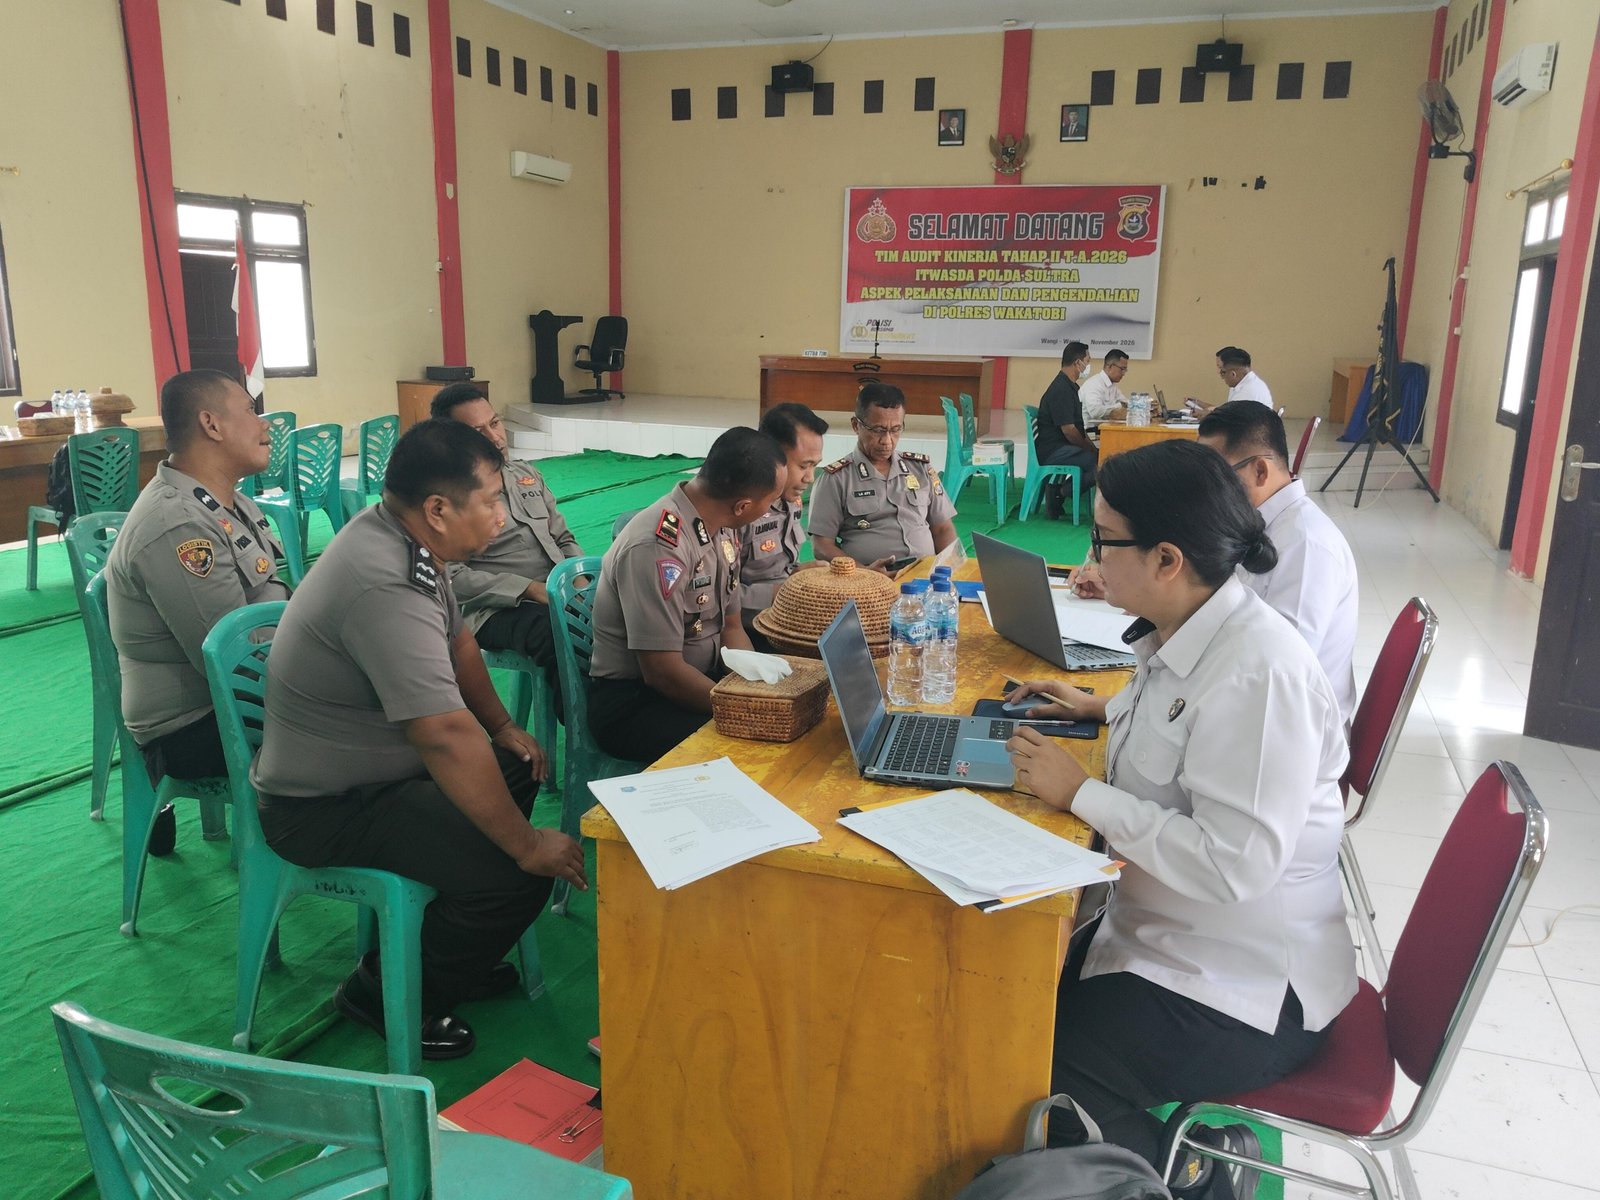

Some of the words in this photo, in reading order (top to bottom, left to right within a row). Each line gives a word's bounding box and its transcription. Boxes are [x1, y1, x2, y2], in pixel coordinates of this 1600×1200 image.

[907, 213, 1009, 240] SELAMAT
[1014, 212, 1104, 240] DATANG
[875, 250, 899, 263] TIM
[901, 250, 942, 263] AUDIT
[943, 250, 999, 263] KINERJA
[1001, 250, 1047, 263] TAHAP
[1050, 250, 1060, 263] II
[915, 269, 975, 282] ITWASDA
[977, 269, 1021, 282] POLDA
[1024, 269, 1080, 283] SULTRA
[860, 287, 901, 299] ASPEK
[904, 287, 999, 301] PELAKSANAAN
[1001, 287, 1030, 301] DAN
[1032, 288, 1139, 302] PENGENDALIAN
[923, 305, 938, 319] DI
[939, 305, 991, 319] POLRES
[993, 306, 1066, 320] WAKATOBI
[178, 540, 210, 553] LOGISTIK
